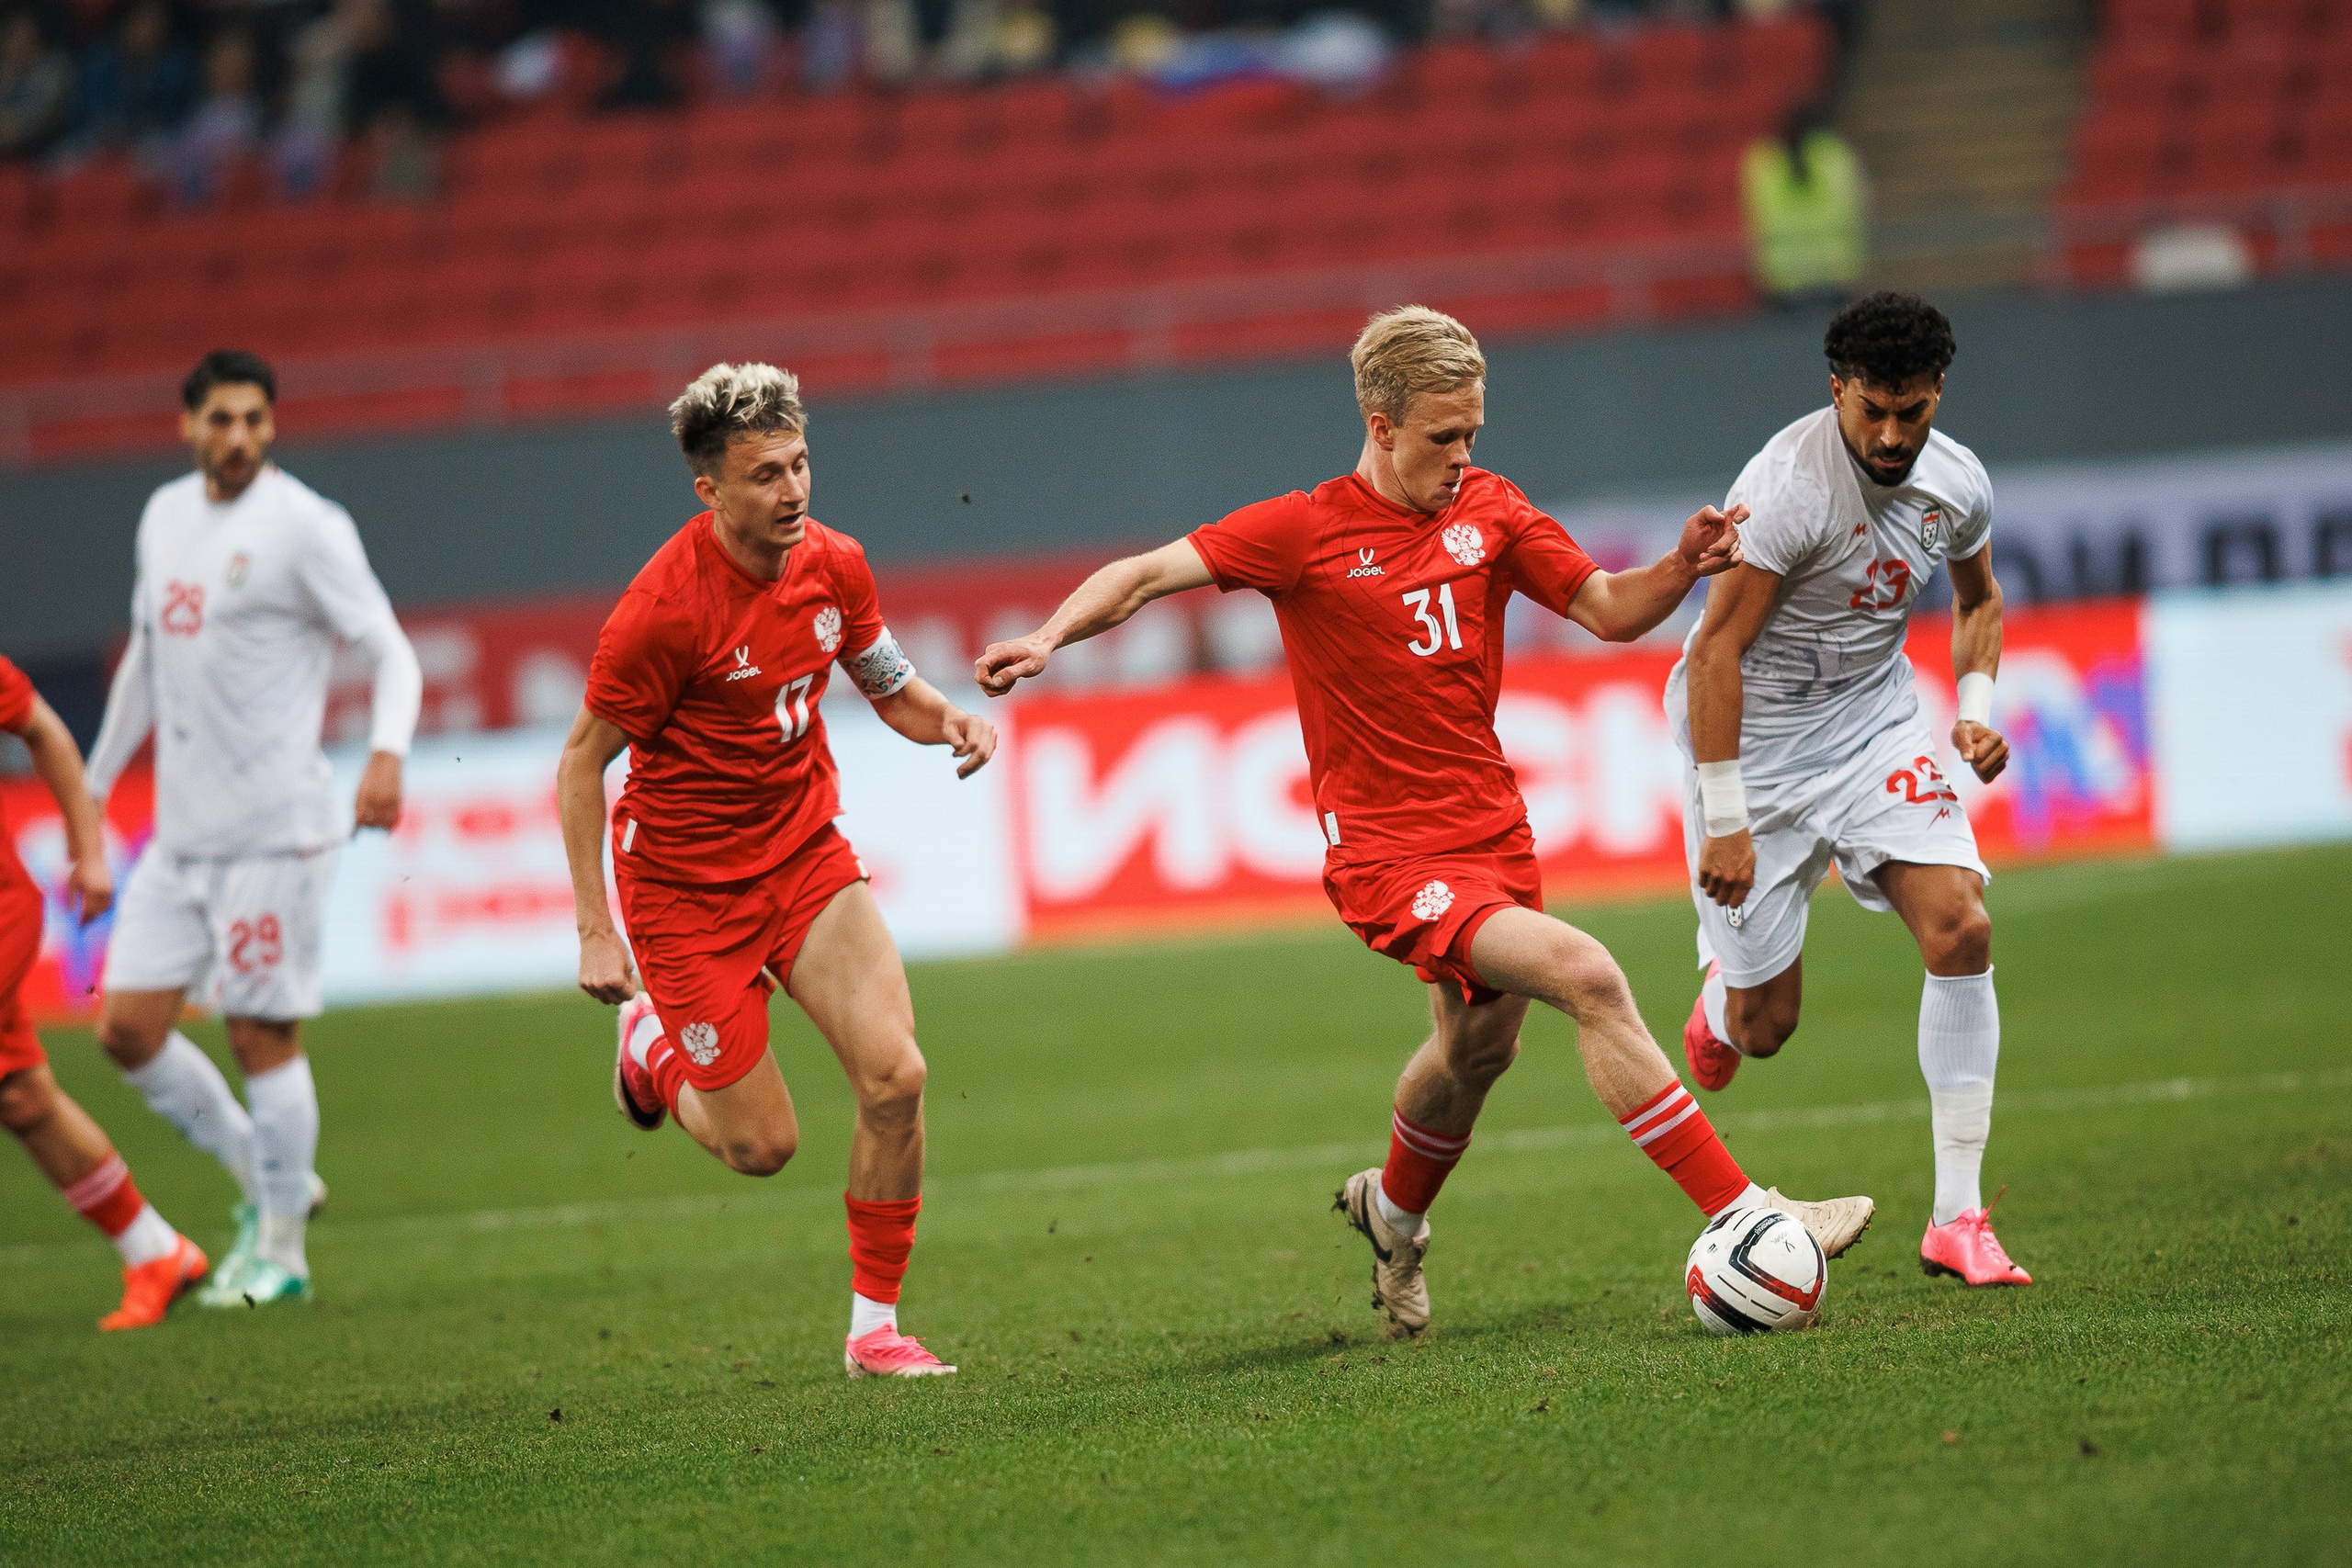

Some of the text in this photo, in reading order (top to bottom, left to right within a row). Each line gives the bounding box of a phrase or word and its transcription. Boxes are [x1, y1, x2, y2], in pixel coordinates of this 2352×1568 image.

[1346, 565, 1385, 579] JOGEL
[159, 578, 206, 637] 29
[1401, 582, 1463, 657] 31
[726, 665, 763, 682] JOGEL
[775, 672, 814, 743] 17
[228, 911, 284, 974] 29
